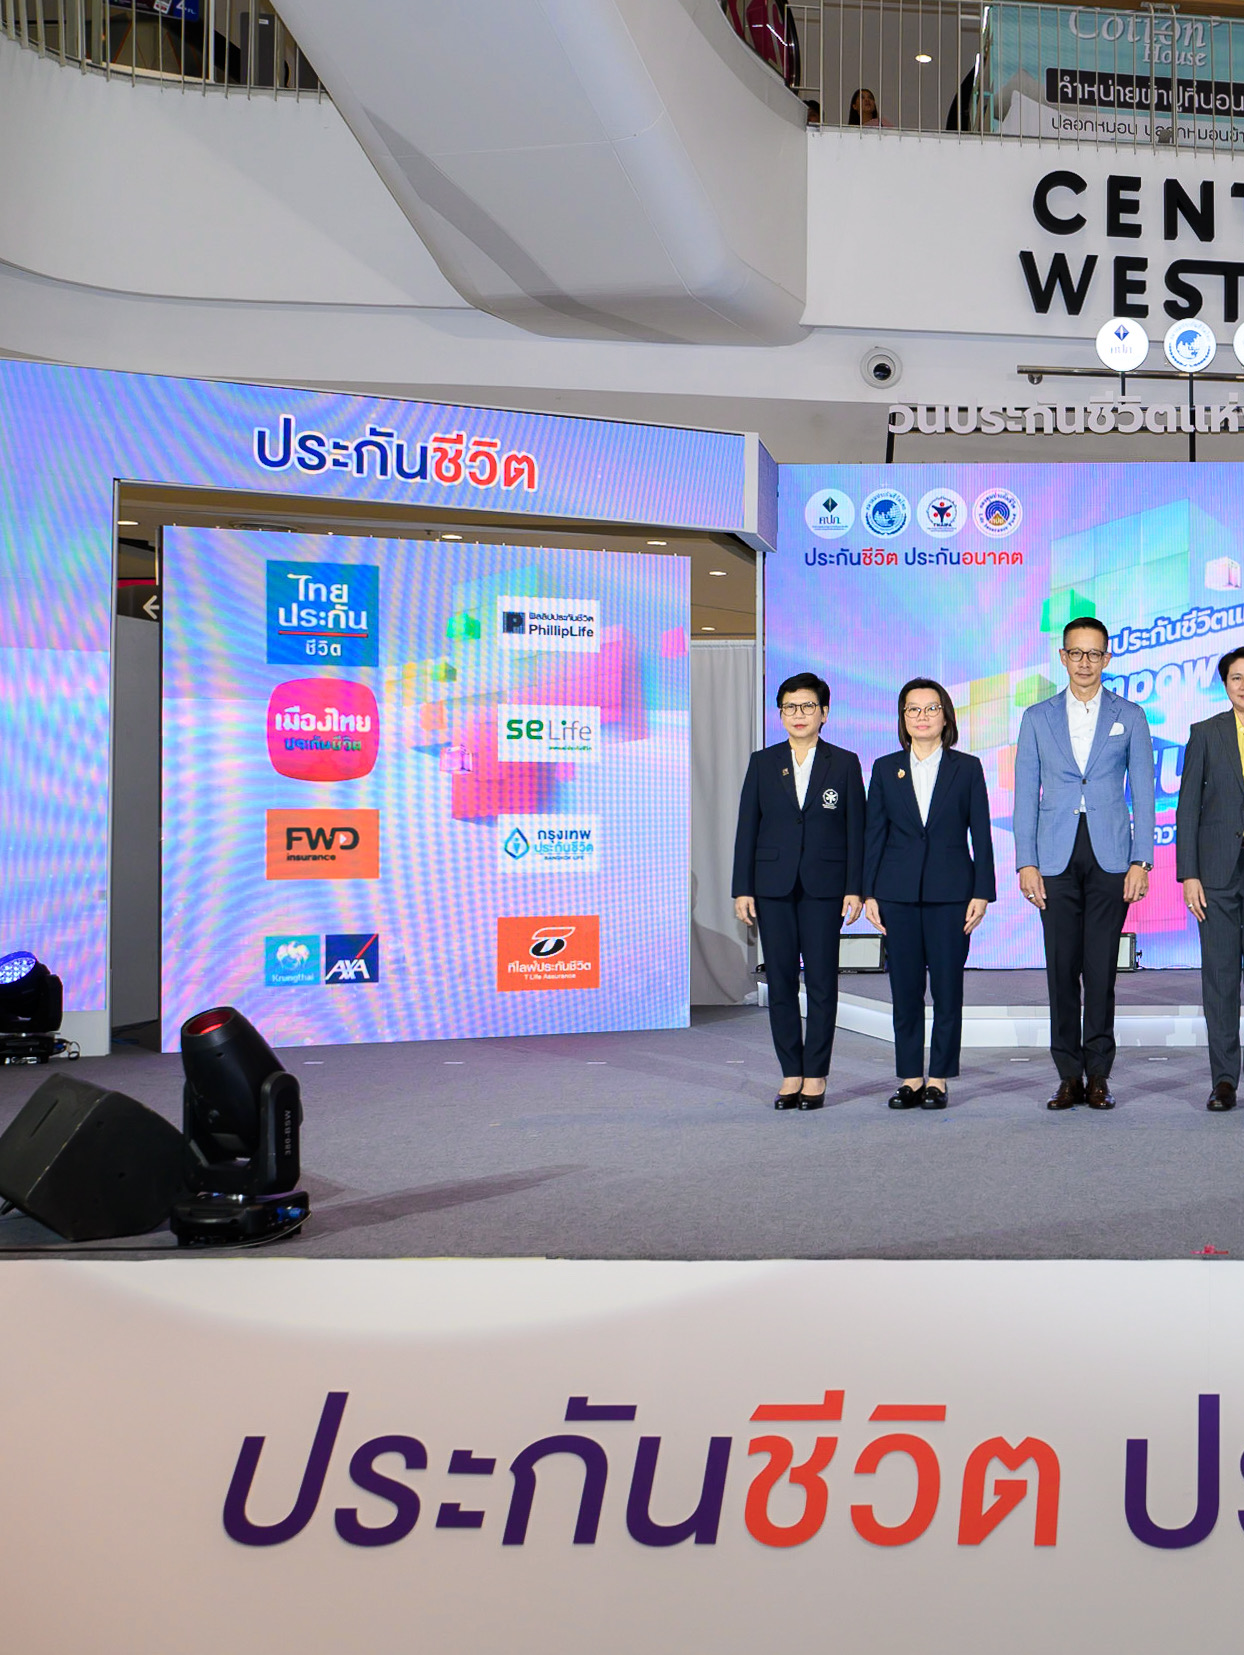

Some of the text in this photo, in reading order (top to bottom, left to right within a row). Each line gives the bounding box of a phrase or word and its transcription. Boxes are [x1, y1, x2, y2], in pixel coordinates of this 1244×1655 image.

[1068, 7, 1207, 48] Cotton
[1142, 43, 1207, 67] House
[256, 416, 536, 490] ประกันชีวิต
[804, 547, 1024, 567] ประกันชีวิต ประกันอนาคต
[287, 573, 348, 604] ไทย
[278, 603, 368, 631] ประกัน
[528, 624, 594, 638] PhillipLife
[305, 638, 342, 657] ชีวิต
[275, 705, 371, 733] เมืองไทย
[286, 827, 360, 851] FWD
[533, 840, 594, 853] ประกันชีวิต
[537, 829, 592, 844] กรุงเทพ
[287, 852, 337, 862] insurance
[272, 973, 315, 985] Krungthai
[325, 958, 371, 981] AXA
[221, 1388, 1062, 1548] ประกันชีวิต
